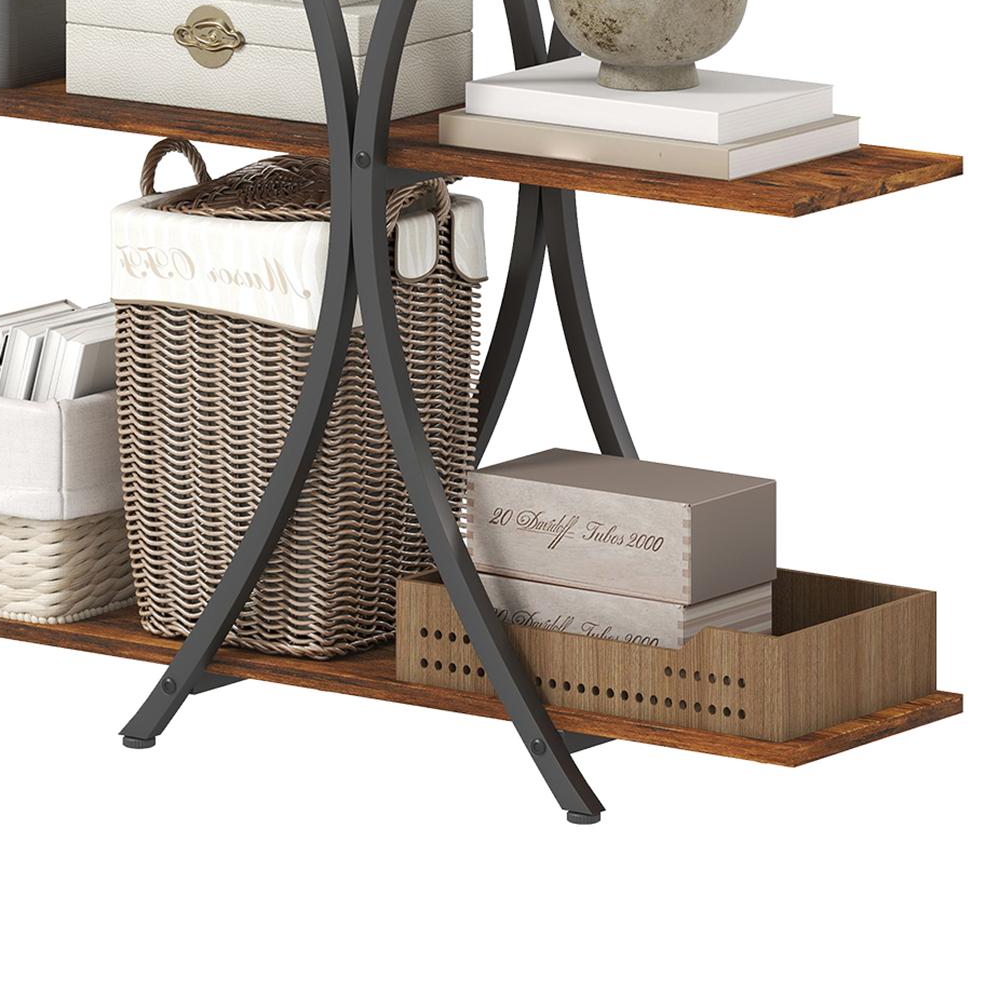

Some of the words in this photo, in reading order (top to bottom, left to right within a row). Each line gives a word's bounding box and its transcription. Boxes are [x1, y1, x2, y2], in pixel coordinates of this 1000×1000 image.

[489, 507, 514, 526] 20
[516, 510, 580, 550] Davidoff
[582, 520, 624, 546] Tubos
[625, 532, 665, 552] 2000
